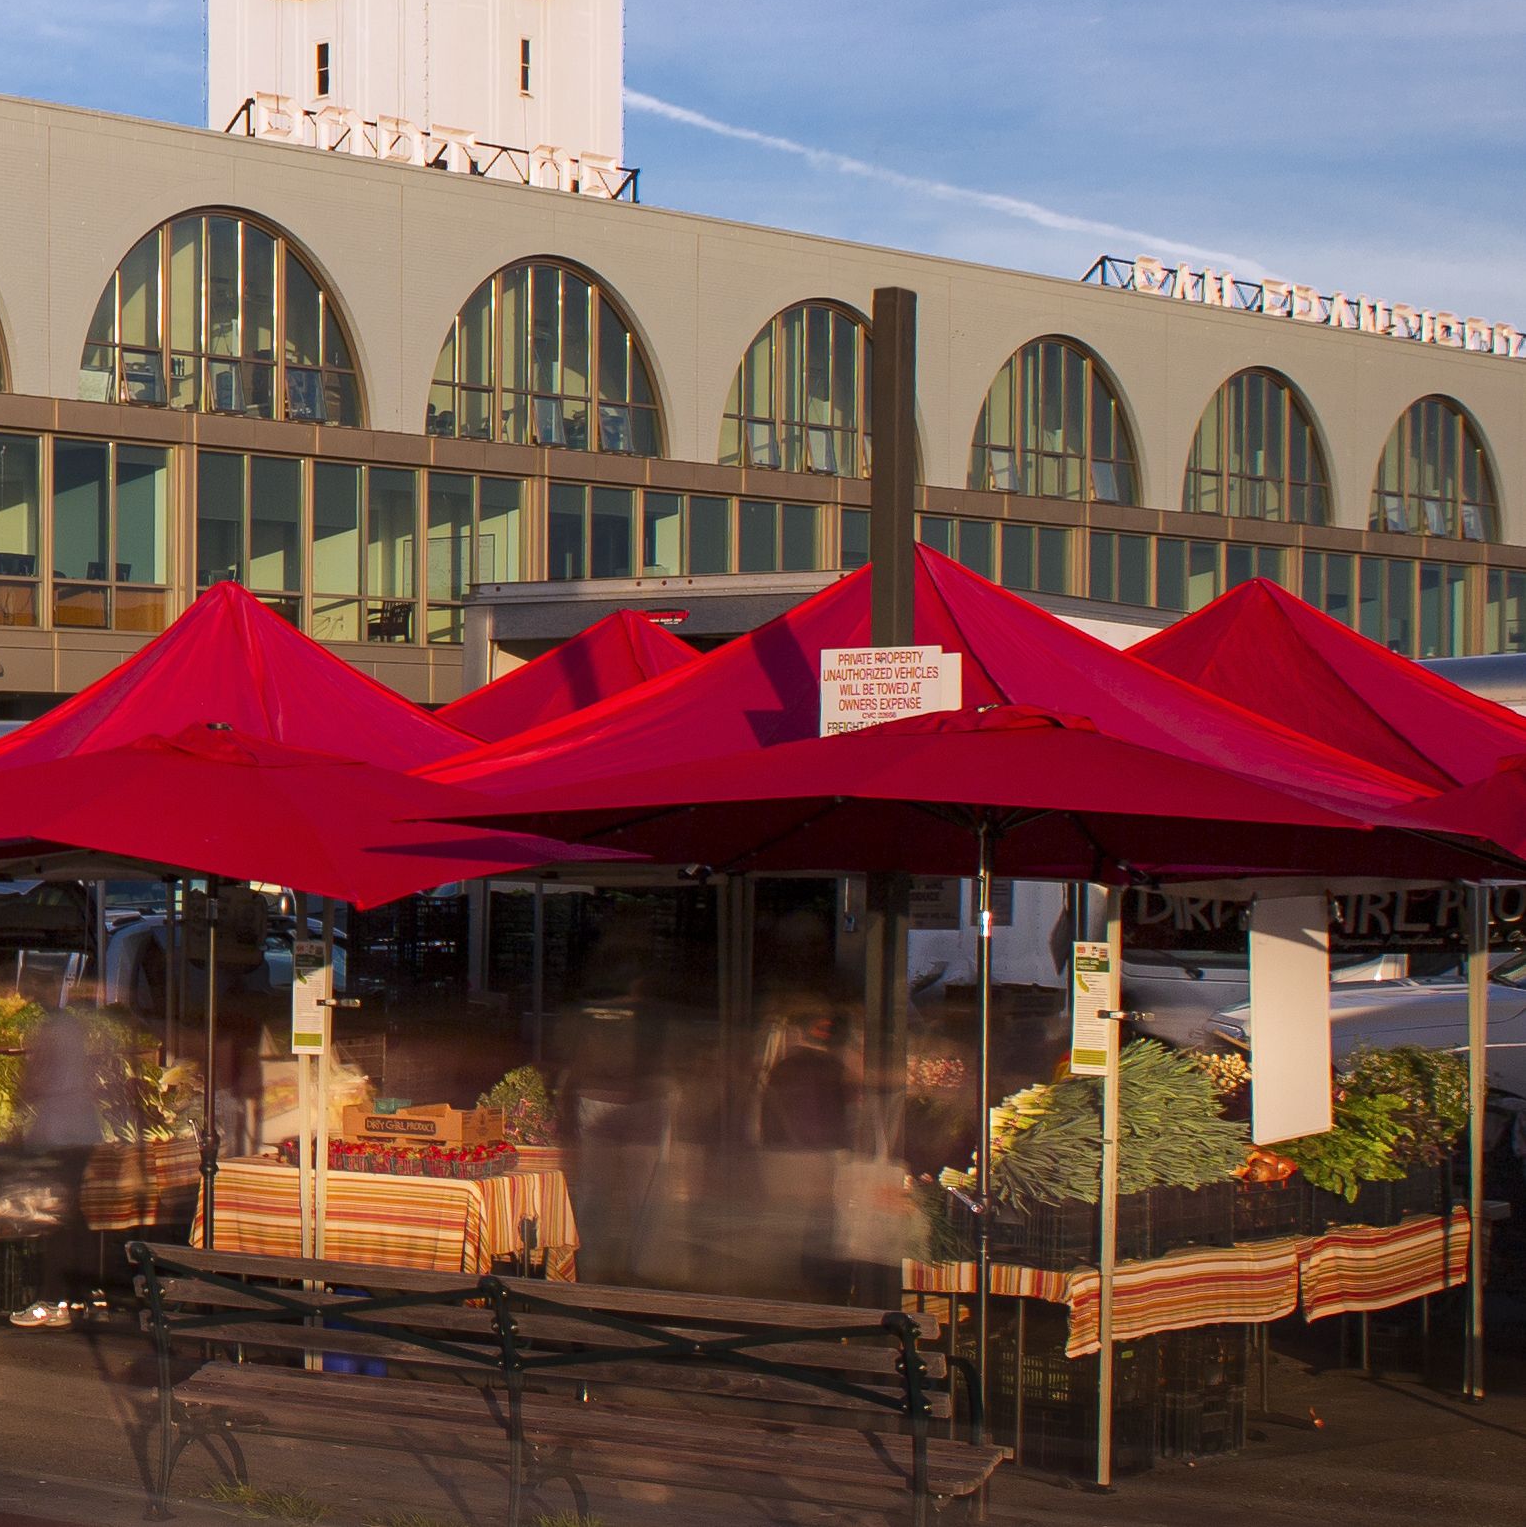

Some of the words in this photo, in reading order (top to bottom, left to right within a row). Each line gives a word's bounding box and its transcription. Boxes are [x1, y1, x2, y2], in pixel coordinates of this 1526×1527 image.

[838, 653, 872, 666] PRIVATE
[875, 651, 924, 664] PROPERTY
[823, 667, 892, 681] UNAUTHORIZED
[894, 666, 939, 679] VEHICLES
[839, 684, 861, 696] WILL
[863, 683, 875, 695] BE
[876, 682, 909, 695] TOWED
[910, 682, 922, 694] AT
[838, 697, 878, 711] OWNERS
[880, 697, 922, 709] EXPENSE
